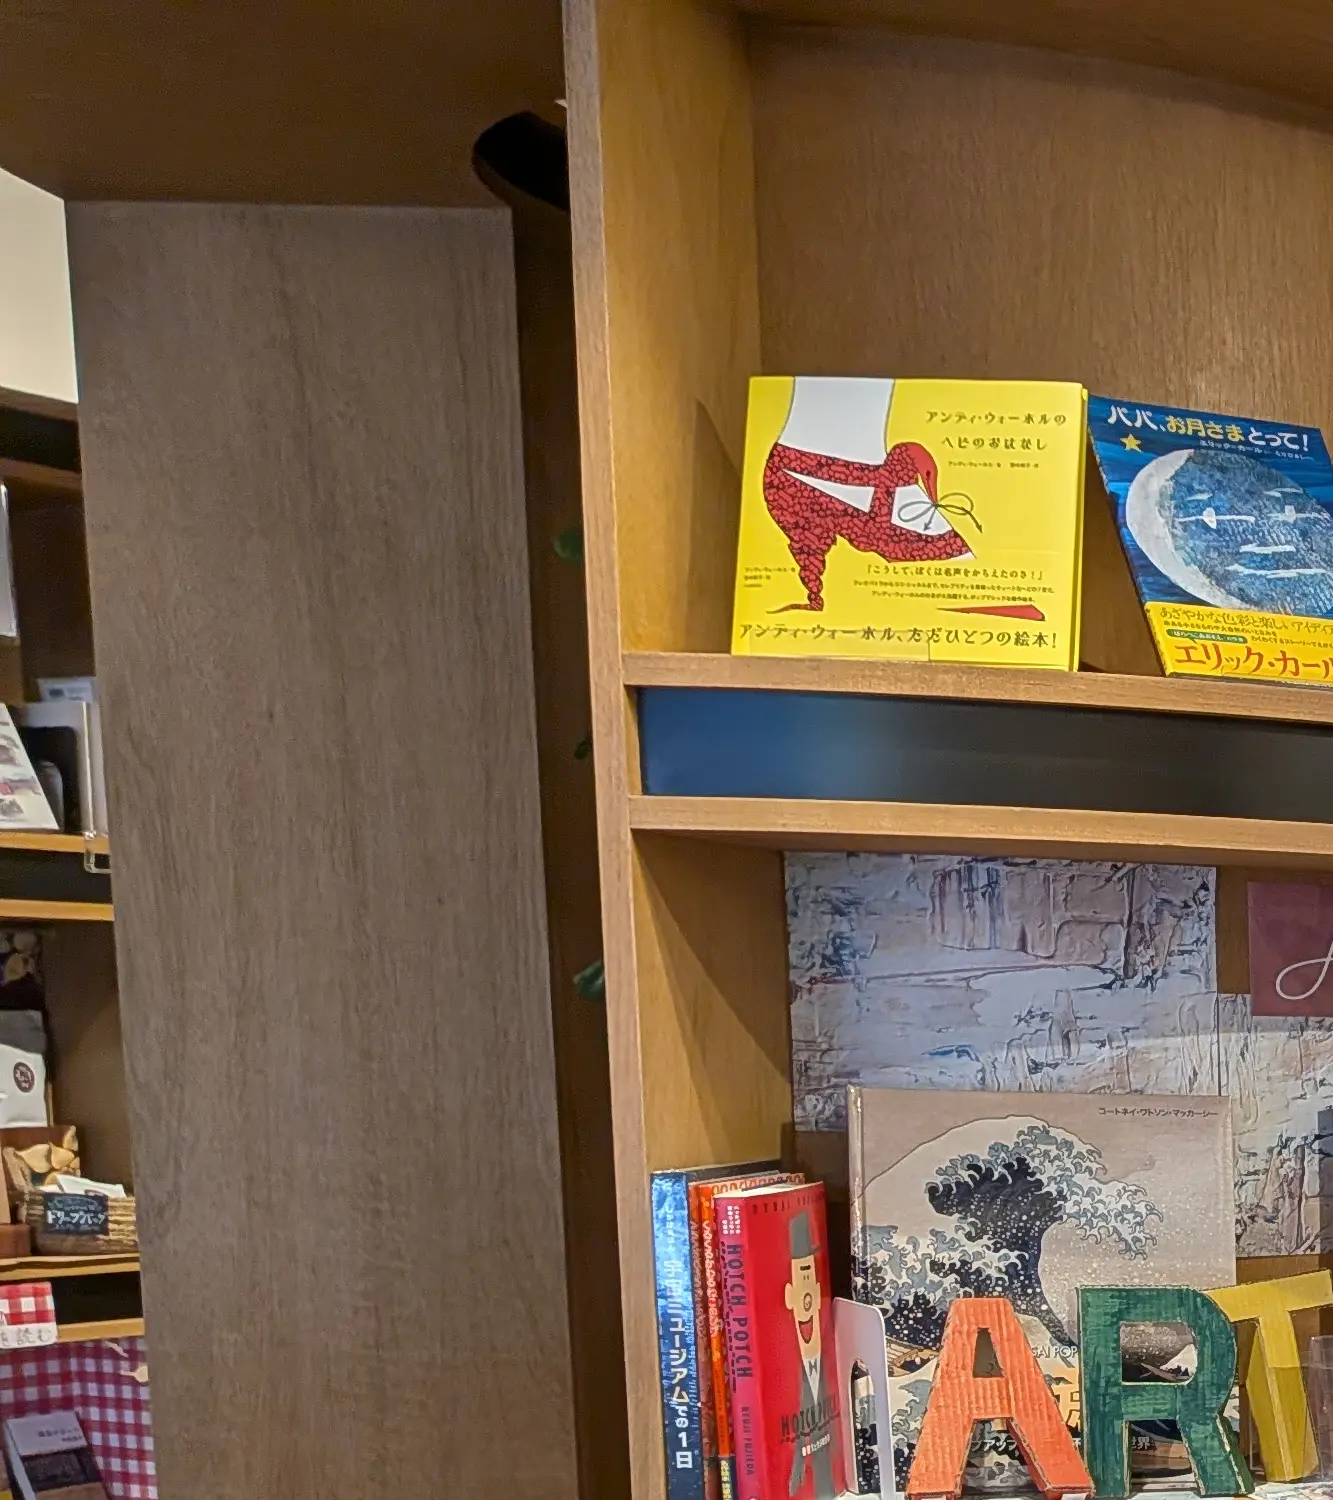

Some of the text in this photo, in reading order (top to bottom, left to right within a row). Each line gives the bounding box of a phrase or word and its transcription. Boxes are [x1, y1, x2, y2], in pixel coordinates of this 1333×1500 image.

[925, 411, 1067, 426] アンディ・ウォーホルの
[941, 437, 1048, 451] ヘビのおはなし
[727, 1242, 753, 1380] HOTCH POTCH
